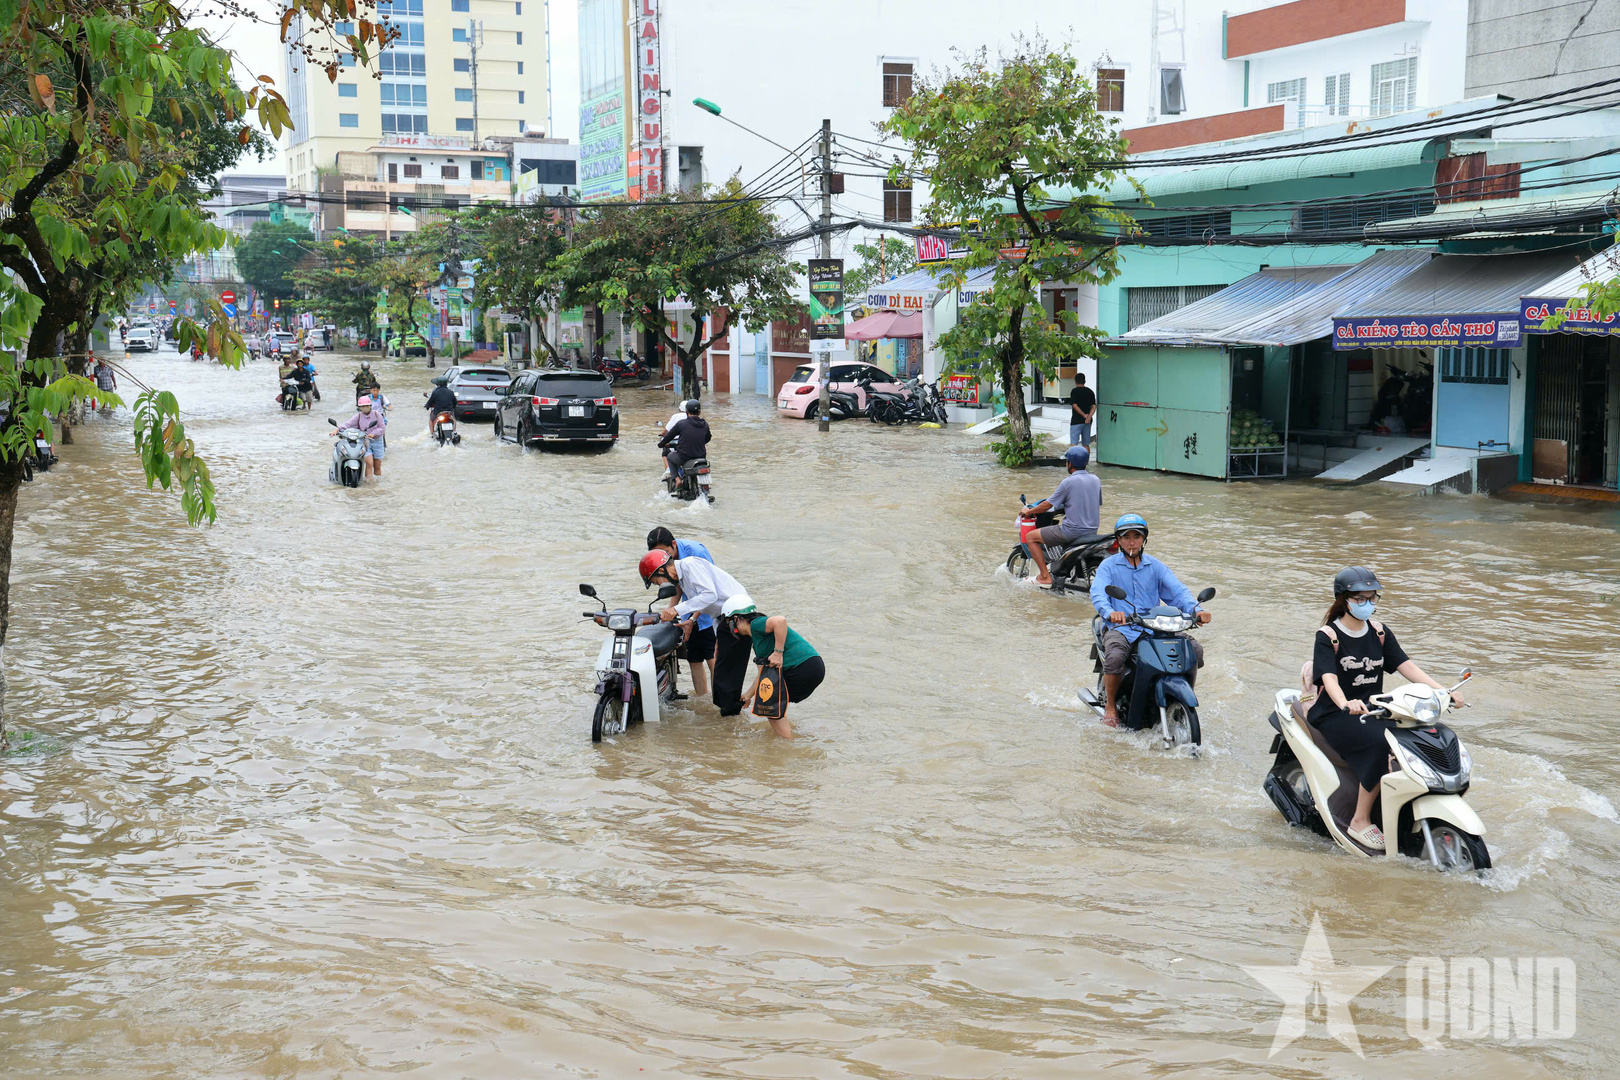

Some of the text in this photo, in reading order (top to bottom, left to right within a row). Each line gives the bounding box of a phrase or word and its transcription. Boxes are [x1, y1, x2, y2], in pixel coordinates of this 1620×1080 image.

[643, 74, 661, 195] NGUYÊ
[868, 294, 887, 306] CƠM
[889, 294, 901, 308] DÌ
[904, 296, 923, 308] HAI
[1524, 304, 1551, 321] CÁ
[1337, 319, 1495, 338] CÁ KIỂNG TÈO CẦN THƠ
